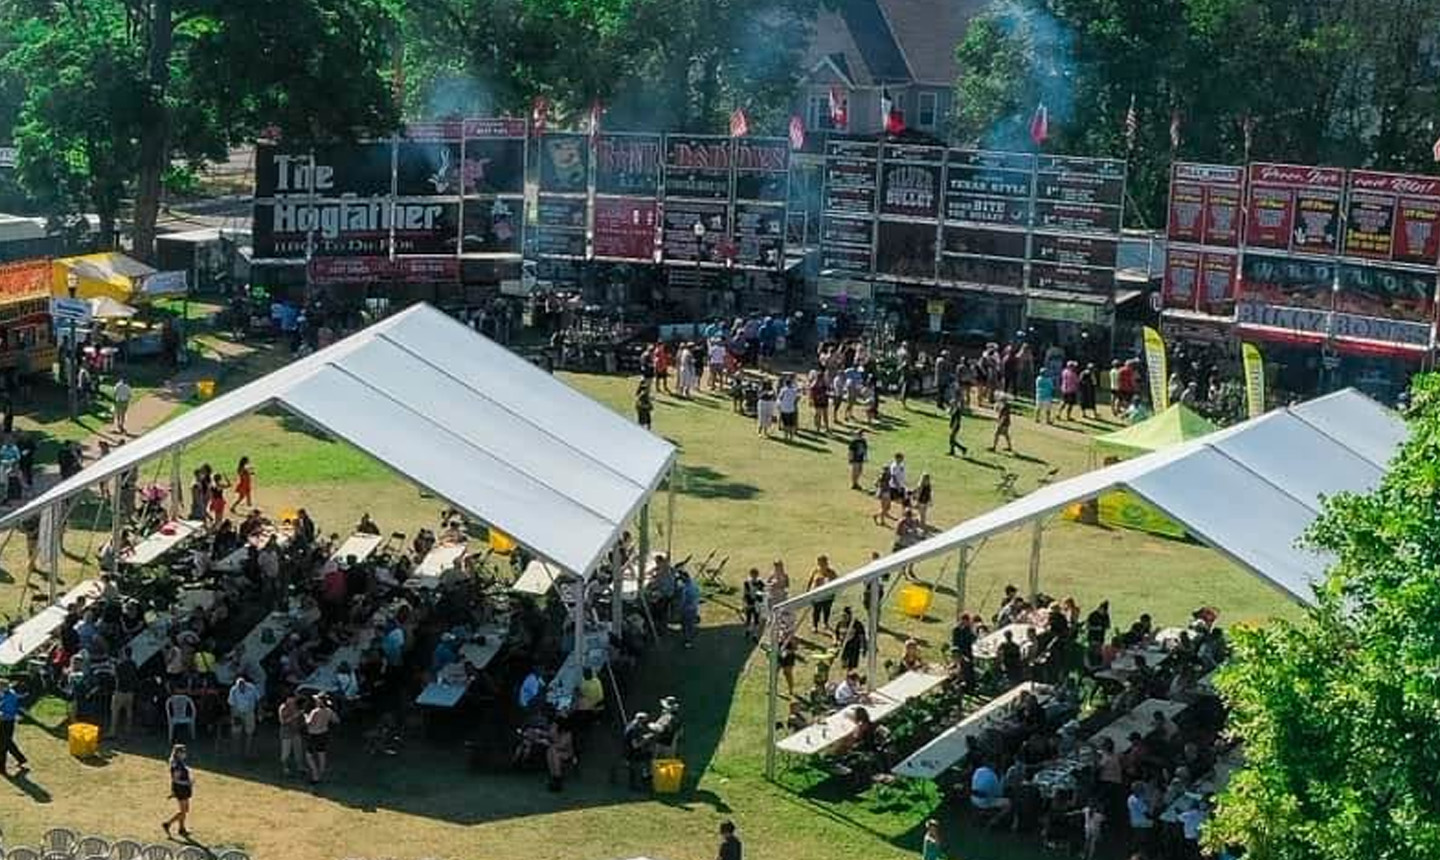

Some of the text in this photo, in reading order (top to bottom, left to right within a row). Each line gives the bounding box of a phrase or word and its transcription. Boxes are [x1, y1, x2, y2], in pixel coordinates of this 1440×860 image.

[273, 155, 334, 190] The
[950, 180, 1027, 194] TEXAS STYLE
[887, 190, 933, 208] BULLET
[974, 200, 1006, 213] BITE
[273, 192, 443, 239] Hogfather
